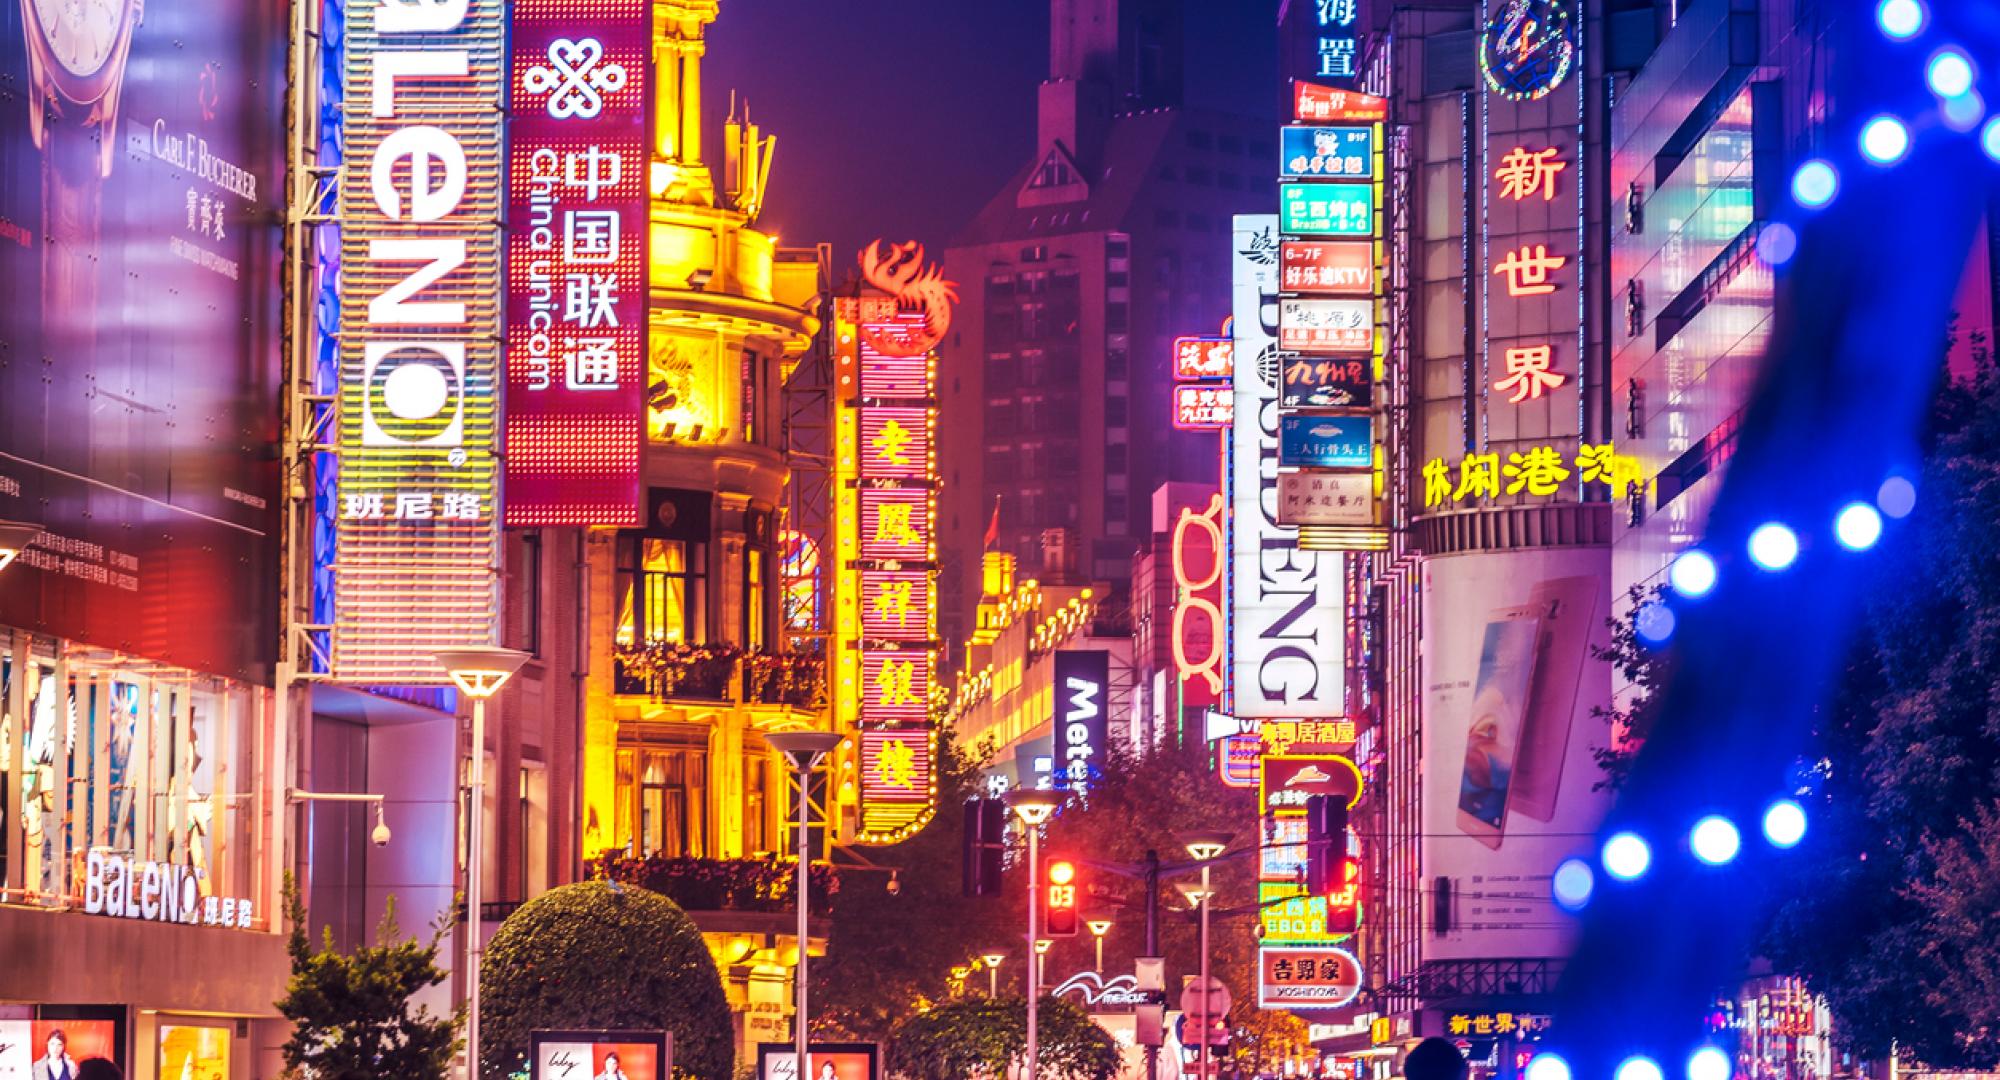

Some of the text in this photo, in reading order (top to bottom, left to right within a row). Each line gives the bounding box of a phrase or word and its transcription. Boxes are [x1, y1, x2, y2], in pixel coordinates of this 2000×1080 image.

[198, 138, 258, 202] BUCHERER
[1290, 201, 1367, 218] 巴西烤肉
[1286, 248, 1323, 260] 6-7F
[527, 147, 558, 391] China unicom
[562, 145, 622, 391] 中国联通
[1286, 267, 1367, 285] 好乐迪KTV
[1494, 145, 1567, 404] 新世界
[344, 493, 481, 521] 班尼路
[1050, 886, 1075, 907] 03
[1274, 959, 1340, 981] 吉野家
[1277, 987, 1339, 997] YOSHINOYA
